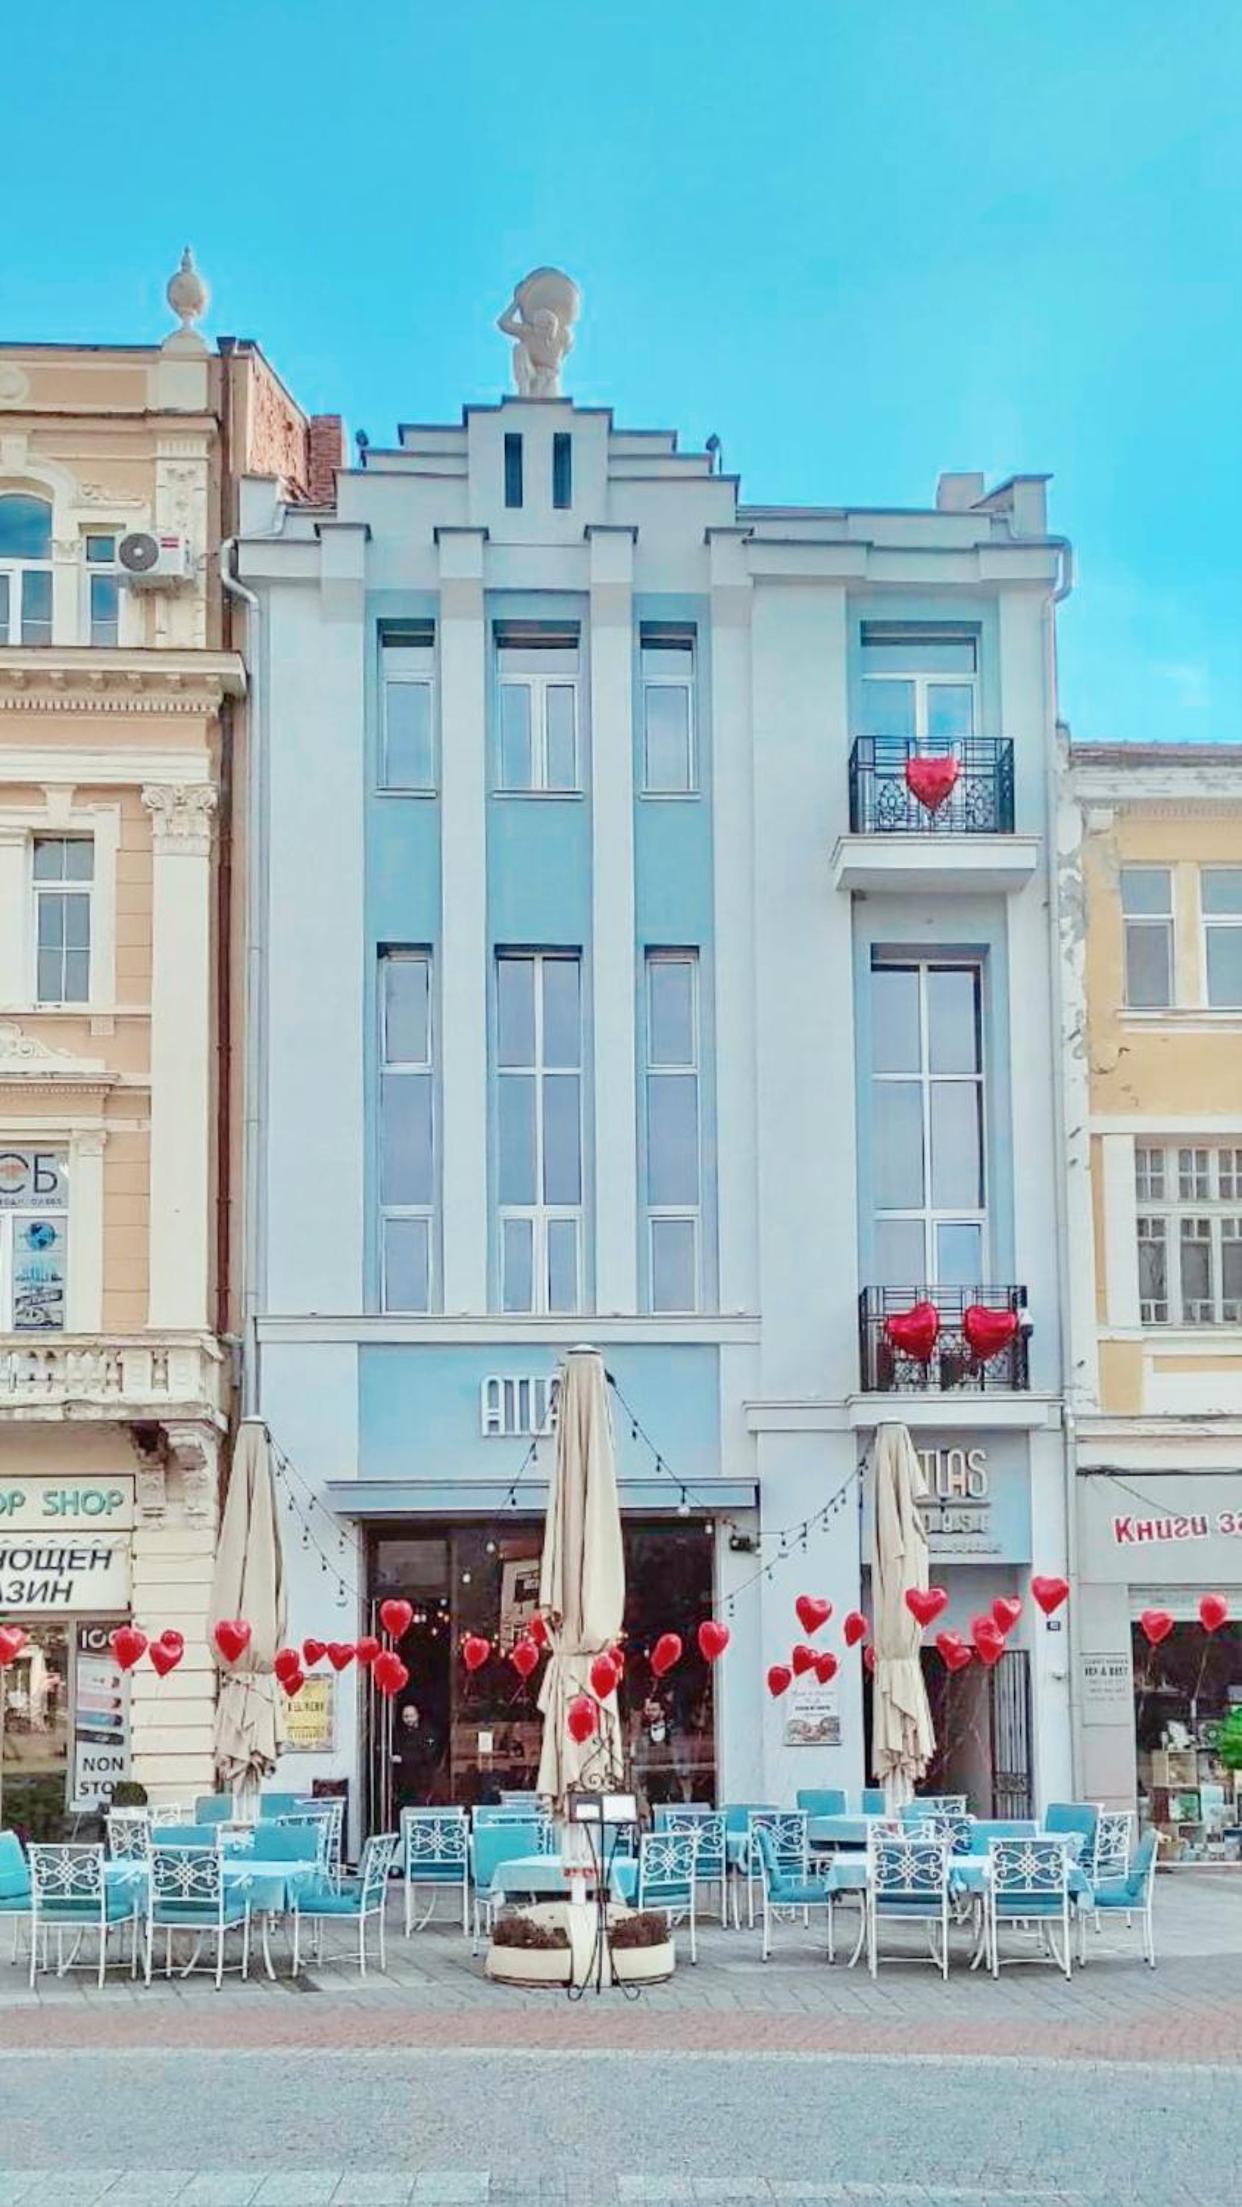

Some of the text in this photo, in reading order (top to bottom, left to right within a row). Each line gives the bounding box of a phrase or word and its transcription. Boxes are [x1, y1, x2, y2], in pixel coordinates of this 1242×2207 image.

[481, 1375, 562, 1436] ATLA
[916, 1449, 988, 1498] TLAS
[42, 1488, 124, 1516] SHOP
[0, 1580, 73, 1603] ЗИН
[83, 1757, 124, 1771] NON
[79, 1781, 116, 1795] STO
